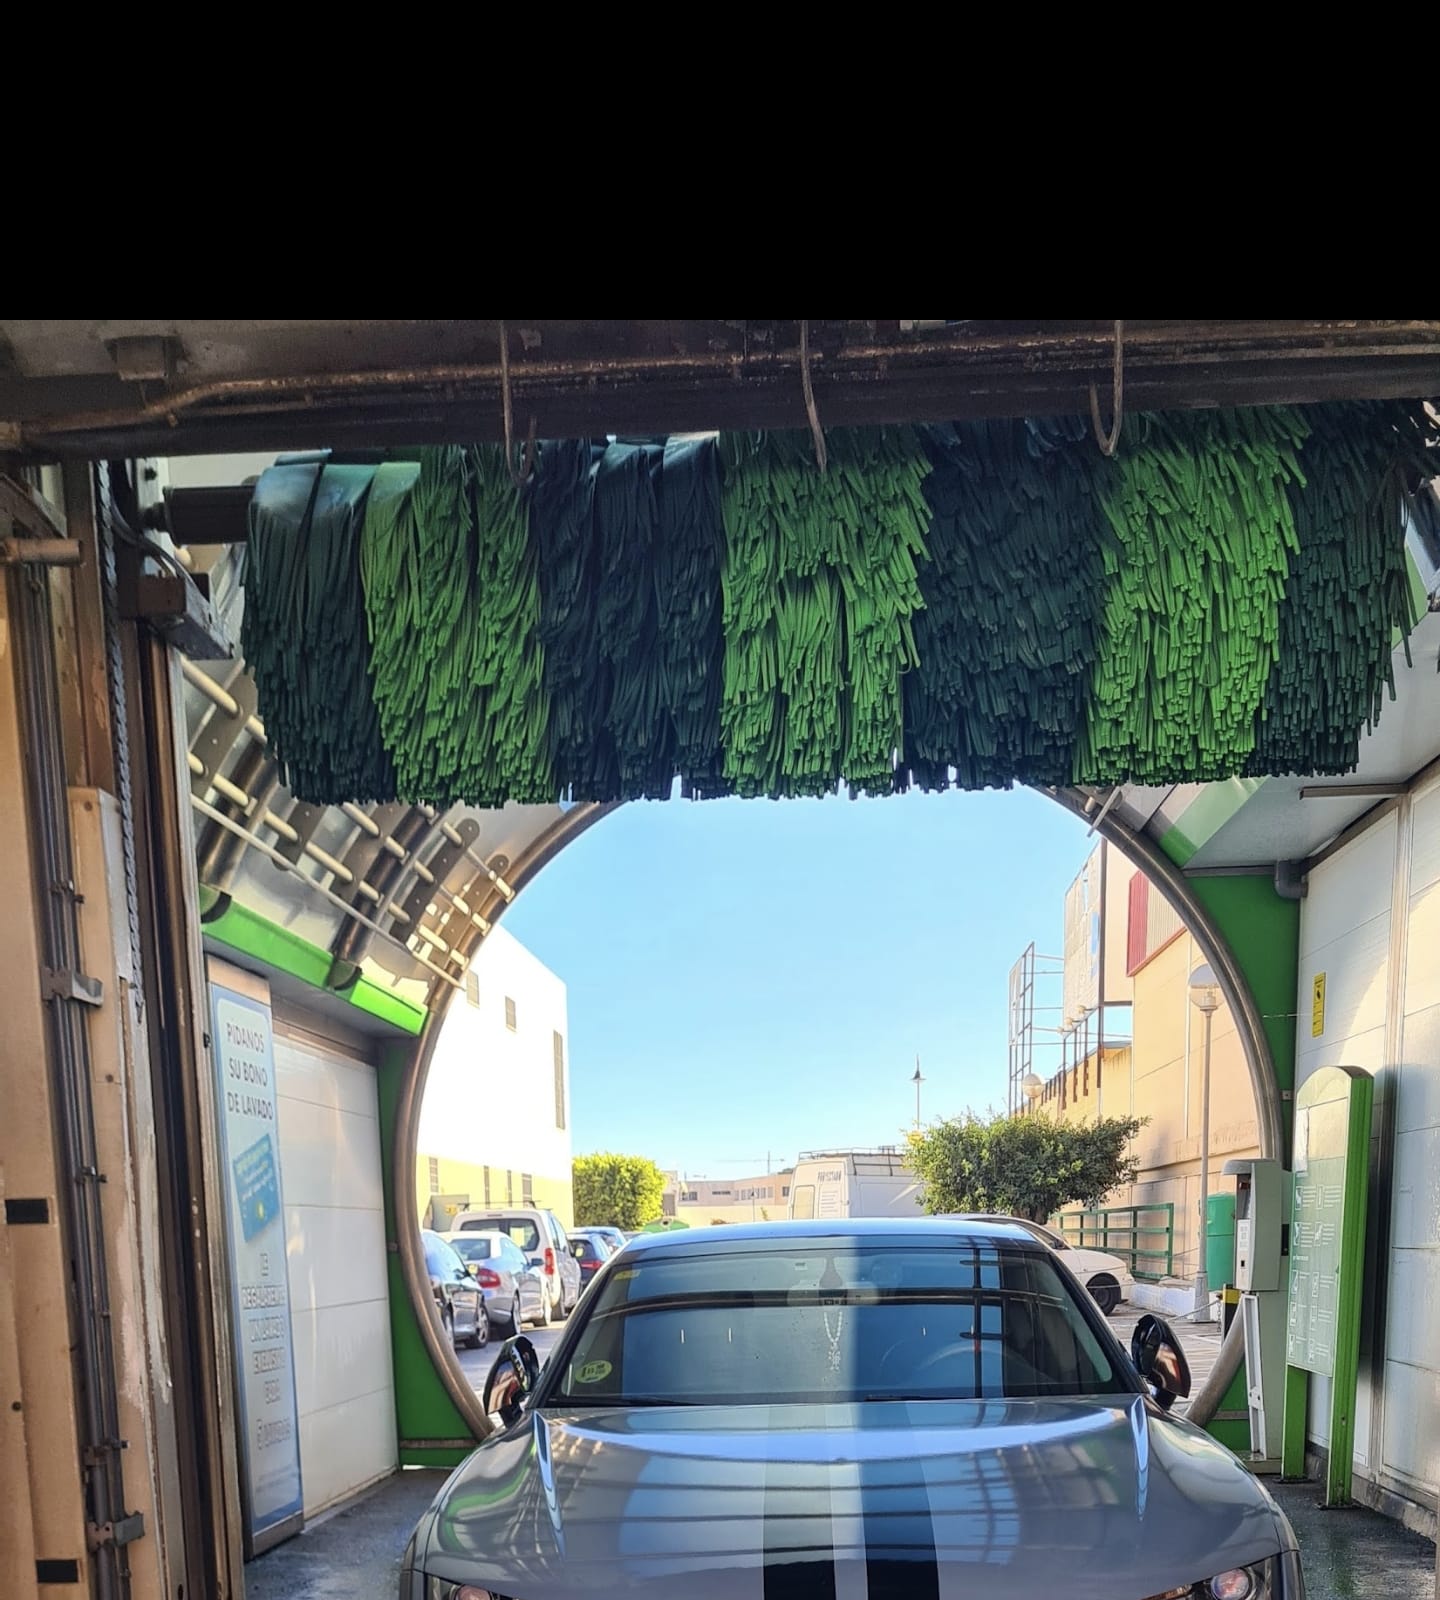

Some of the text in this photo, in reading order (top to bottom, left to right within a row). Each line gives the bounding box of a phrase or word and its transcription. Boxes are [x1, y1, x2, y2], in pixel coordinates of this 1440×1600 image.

[229, 1057, 268, 1087] SU BONO
[227, 1091, 274, 1121] DE LAVADO
